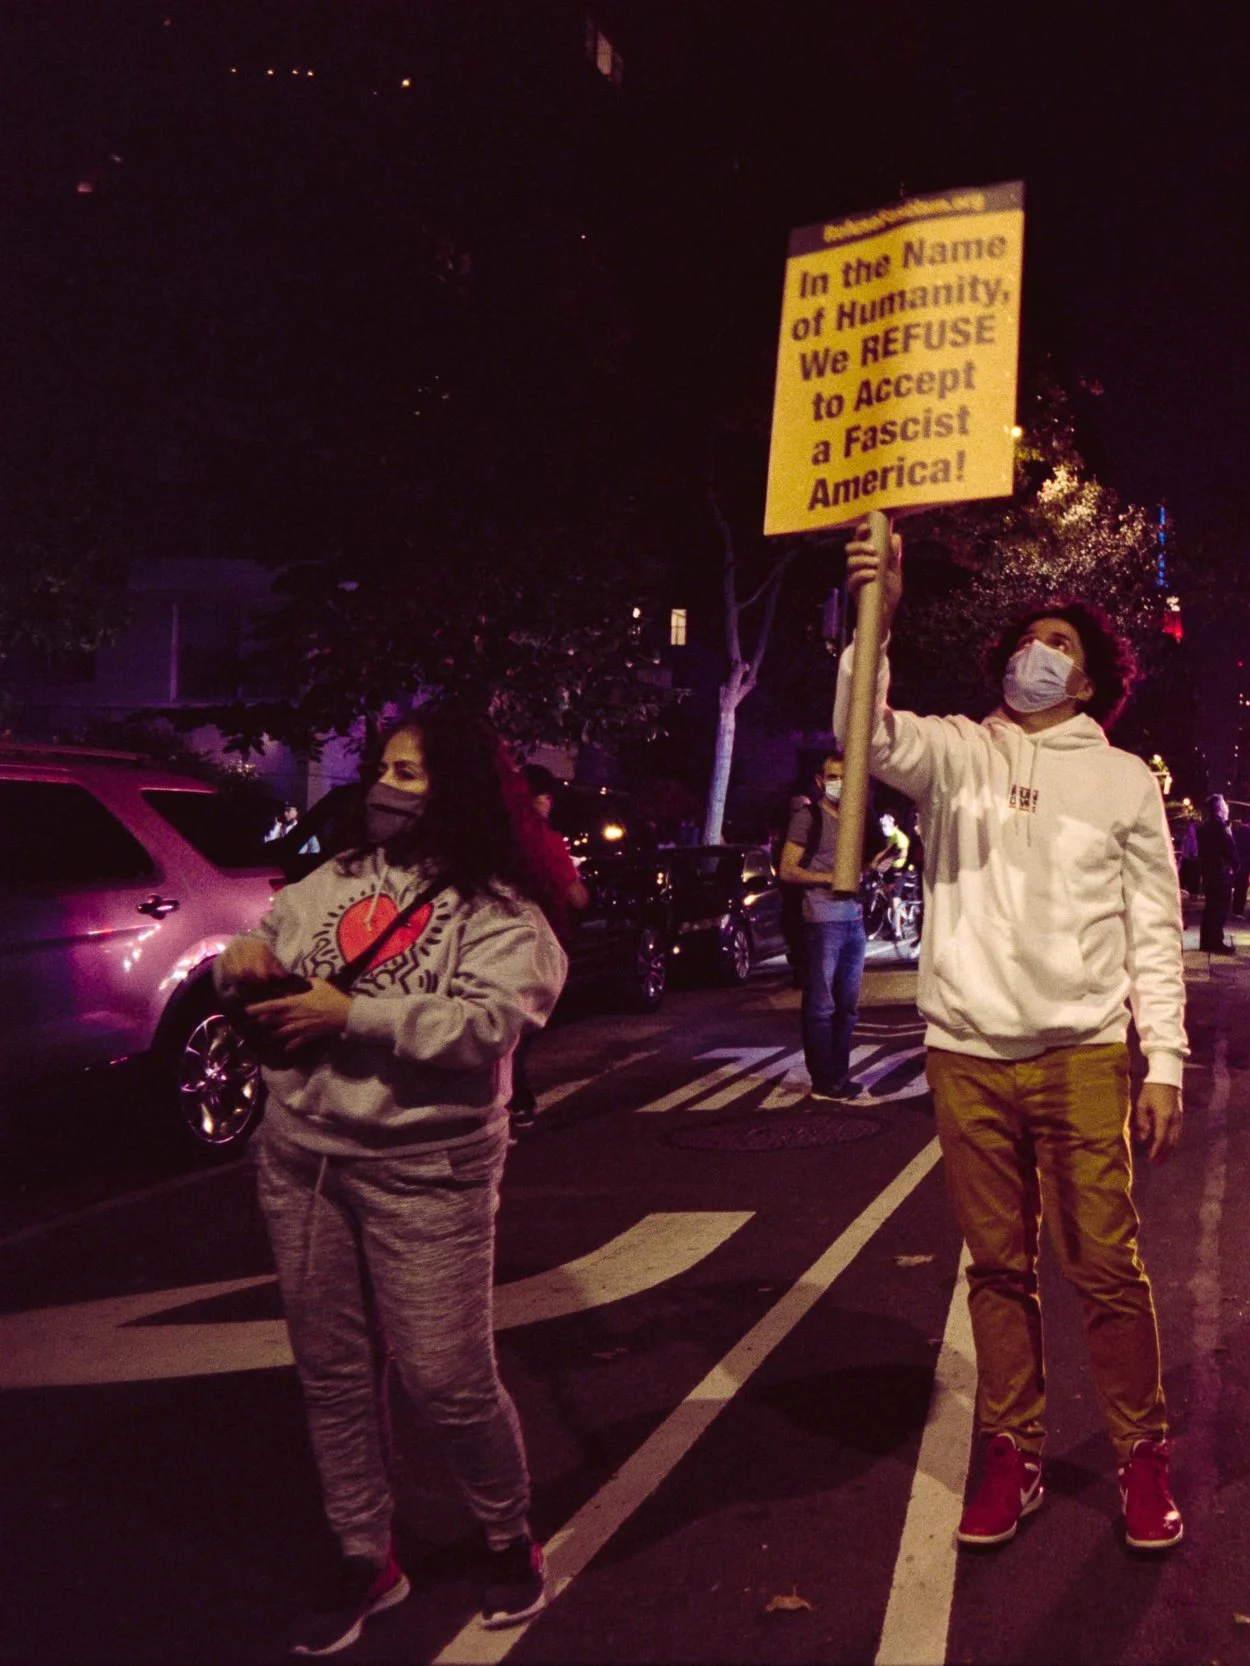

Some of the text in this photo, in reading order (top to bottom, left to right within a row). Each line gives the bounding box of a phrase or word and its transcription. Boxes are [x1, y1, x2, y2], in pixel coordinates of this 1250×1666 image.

[800, 233, 1009, 300] In the Name
[791, 277, 1011, 342] of Humanity,
[799, 313, 996, 382] We REFUSE
[811, 359, 977, 422] to Accept
[811, 404, 970, 466] a Fascist
[807, 449, 967, 512] America!
